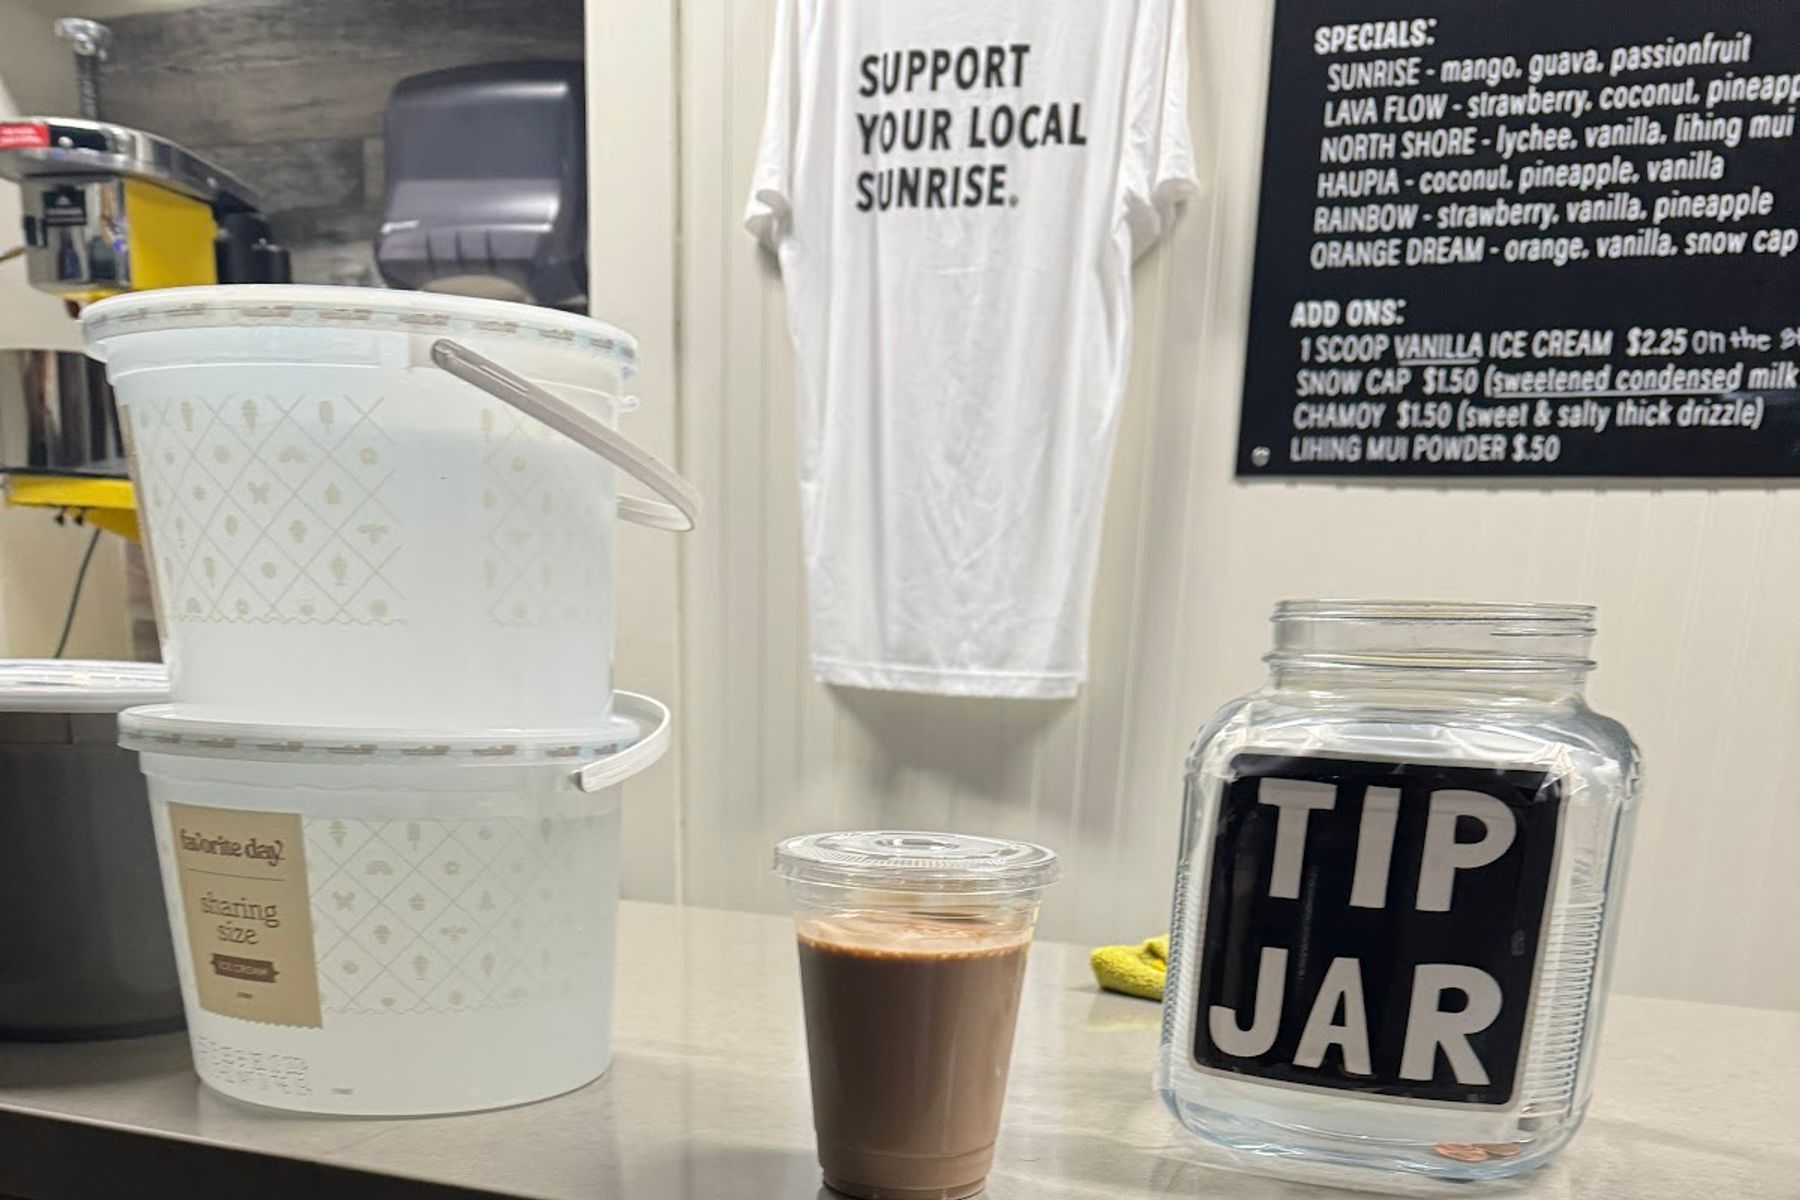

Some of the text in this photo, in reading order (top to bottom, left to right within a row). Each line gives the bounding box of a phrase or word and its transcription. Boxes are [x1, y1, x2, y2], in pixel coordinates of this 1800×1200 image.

[1314, 18, 1438, 55] SPECIALS:
[859, 43, 1031, 98] SUPPORT
[1327, 57, 1422, 92] SUNRISE
[1610, 31, 1752, 77] passionfruit
[856, 102, 1087, 155] YOUR LOCAL
[1324, 96, 1378, 128] LAVA
[1383, 93, 1449, 123] FLOW
[1320, 132, 1397, 164] NORTH
[1401, 127, 1478, 160] SHORE
[1674, 111, 1743, 148] lihing
[1749, 106, 1796, 139] mui
[1316, 167, 1400, 199] HAUPIA
[1647, 150, 1725, 183] vanilla
[1313, 203, 1419, 234] RAINBOW
[1653, 185, 1774, 225] pineapple
[1310, 238, 1402, 271] ORANGE
[1406, 236, 1485, 266] DREAM
[1684, 230, 1748, 256] snow
[1753, 227, 1799, 258] cap
[1290, 298, 1407, 328] ADD ONS:
[1301, 336, 1312, 363] 1
[1315, 334, 1389, 364] SCOOP
[1394, 331, 1484, 361] VANILLA
[1489, 329, 1529, 359] ICE
[1531, 328, 1614, 359] CREAM
[1626, 326, 1689, 357] $2.25
[1729, 326, 1773, 352] the
[1296, 368, 1362, 397] SNOW
[1365, 367, 1412, 396] CAP
[1484, 362, 1612, 399] (sweetened
[1615, 361, 1744, 395] condensed
[1293, 401, 1388, 430] CHAMOY
[1456, 398, 1529, 432] (sweet
[1533, 399, 1552, 428] &
[1557, 398, 1611, 433] salty
[1615, 398, 1674, 428] thick
[1676, 396, 1765, 431] drizzle)
[1290, 432, 1561, 463] LIHING MUI POWDER $.50
[1258, 778, 1517, 913] TIP
[1208, 946, 1503, 1086] JAR
